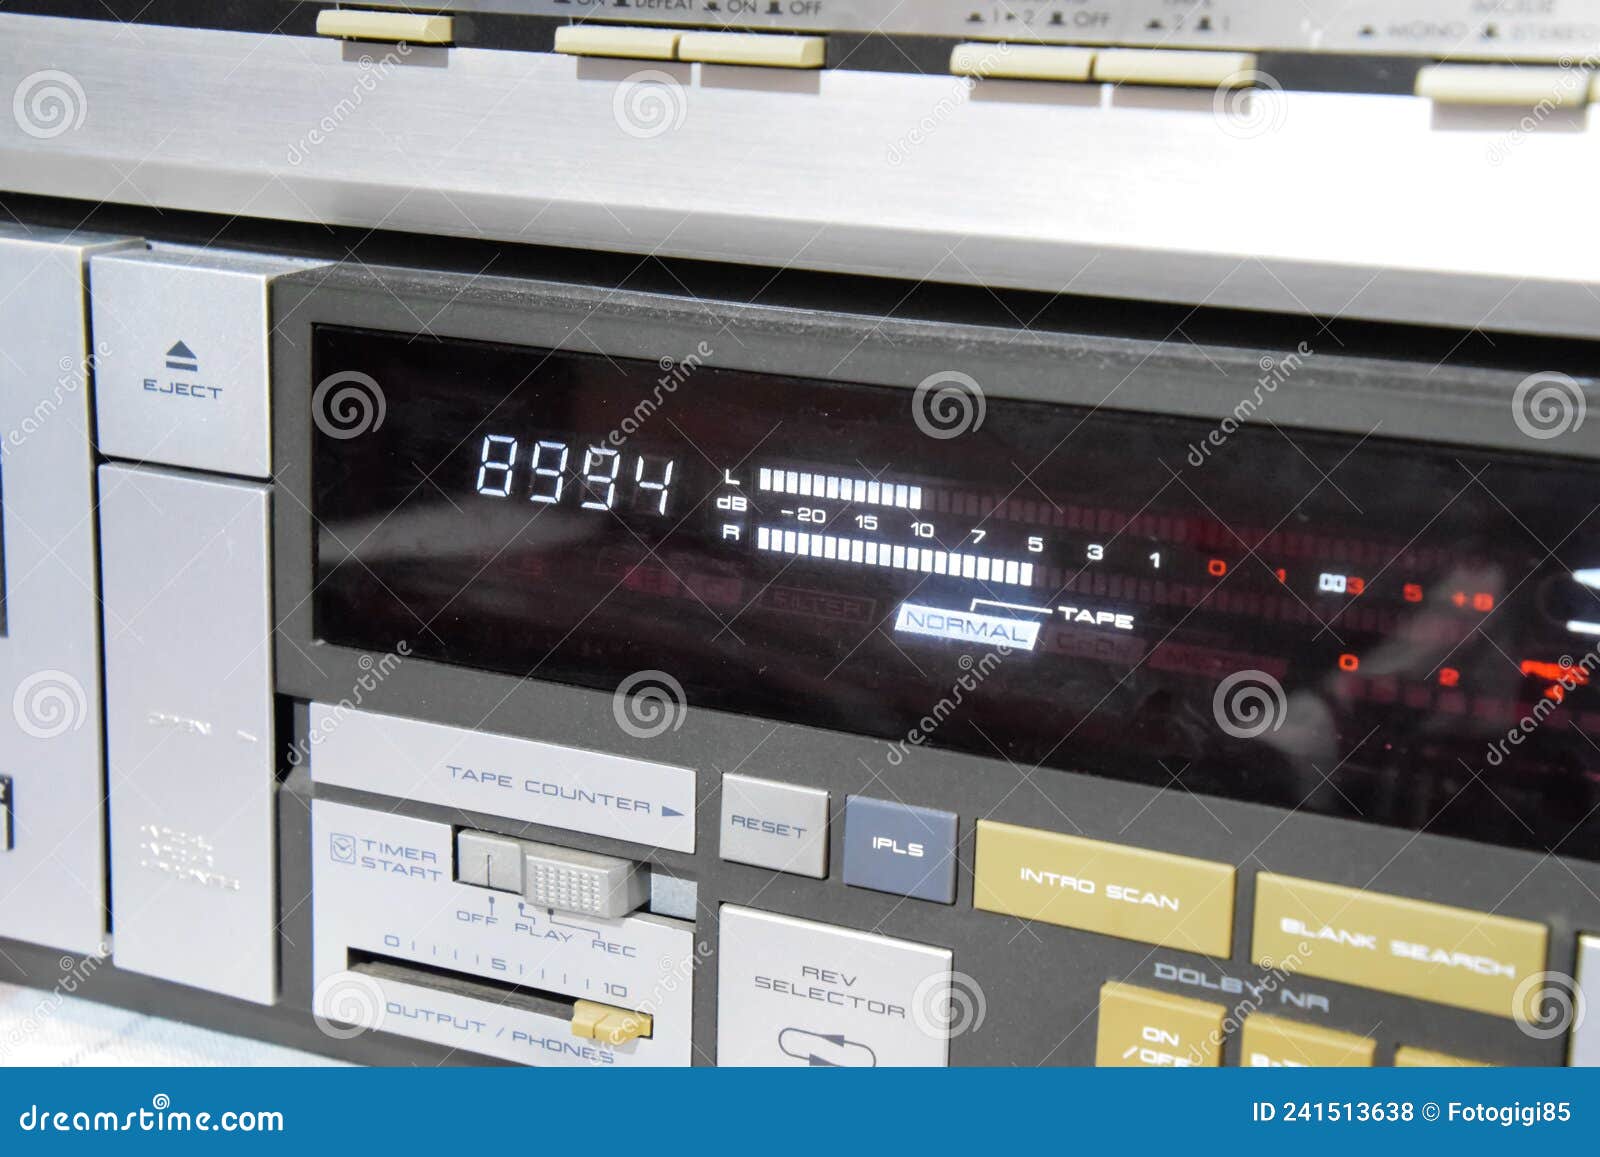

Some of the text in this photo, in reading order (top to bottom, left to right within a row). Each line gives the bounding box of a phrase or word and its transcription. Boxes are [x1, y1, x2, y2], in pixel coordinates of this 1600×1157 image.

[789, 1, 822, 15] OFF
[1073, 12, 1110, 27] OFF
[143, 378, 223, 400] EJECT
[476, 434, 674, 516] 8994
[725, 468, 741, 486] L
[716, 495, 748, 512] dB
[722, 524, 741, 541] R
[855, 515, 878, 531] 15
[911, 522, 935, 538] 10
[971, 528, 987, 544] 7
[1028, 536, 1044, 553] 5
[1087, 543, 1104, 561] 3
[1149, 552, 1161, 568] 1
[1207, 559, 1227, 577] 0
[906, 610, 1029, 643] NORMAL
[1057, 605, 1135, 630] TAPE
[446, 765, 652, 815] TAPE COUNTER
[731, 814, 808, 840] RESET
[360, 838, 438, 865] TIMER
[872, 836, 924, 857] IPLS
[360, 857, 443, 882] START
[1020, 867, 1180, 911] INTRO SCAN
[455, 910, 499, 926] OFF
[514, 922, 574, 944] PLAY
[591, 939, 637, 959] REC
[1279, 917, 1517, 980] BLANK SEARCH
[384, 935, 628, 998] 0 5 10
[801, 965, 857, 988] REV
[753, 976, 906, 1019] SELECTOR
[1154, 961, 1330, 1014] DOLBY NR
[386, 1002, 487, 1034] OUTPUT
[512, 1030, 614, 1065] PHONES
[1141, 1026, 1181, 1047] ON
